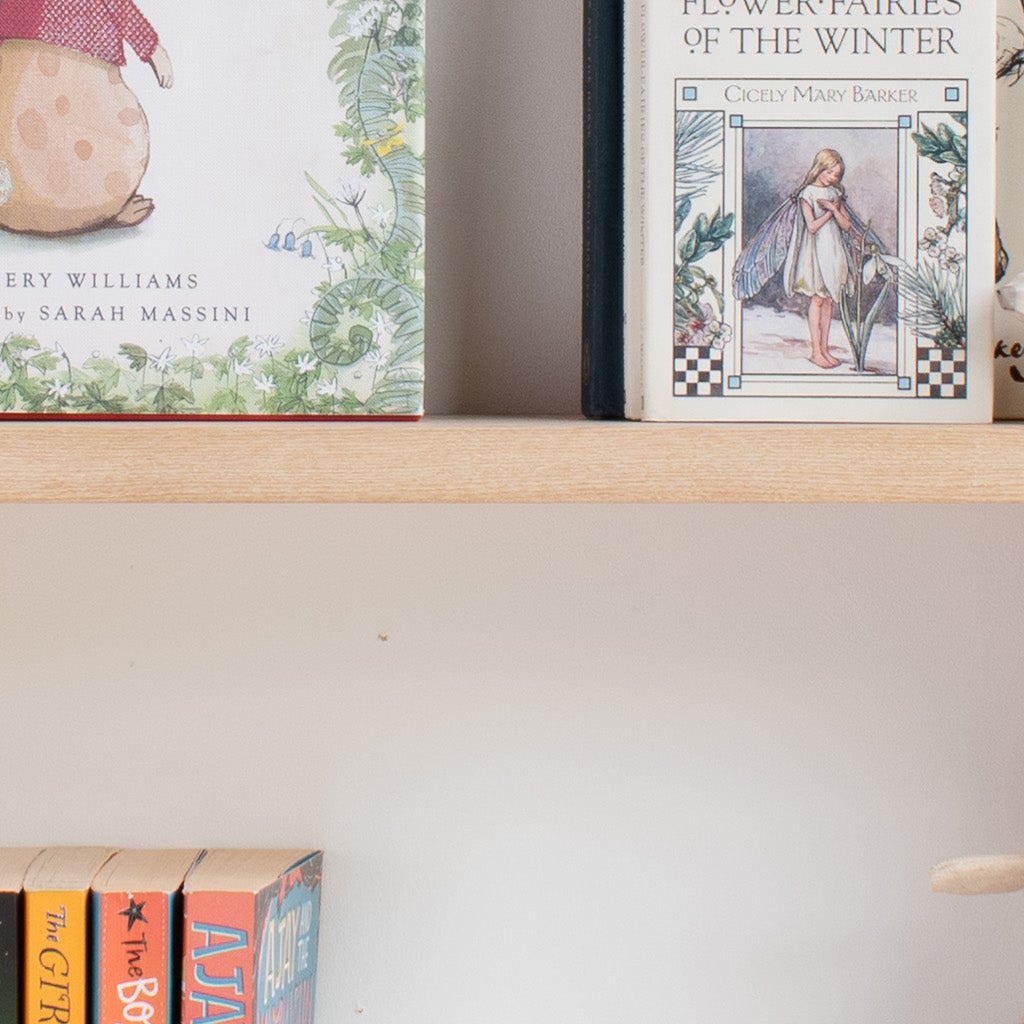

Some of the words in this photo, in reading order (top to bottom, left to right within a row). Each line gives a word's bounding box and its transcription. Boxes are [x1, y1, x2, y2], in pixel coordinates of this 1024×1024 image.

[683, 26, 721, 55] OF
[729, 27, 803, 55] THE
[813, 27, 960, 55] WINTER
[67, 272, 199, 290] WILLIAMS
[4, 305, 26, 324] by
[39, 305, 126, 322] SARAH
[140, 306, 251, 322] MASSINI
[46, 904, 67, 943] The
[120, 932, 148, 978] The
